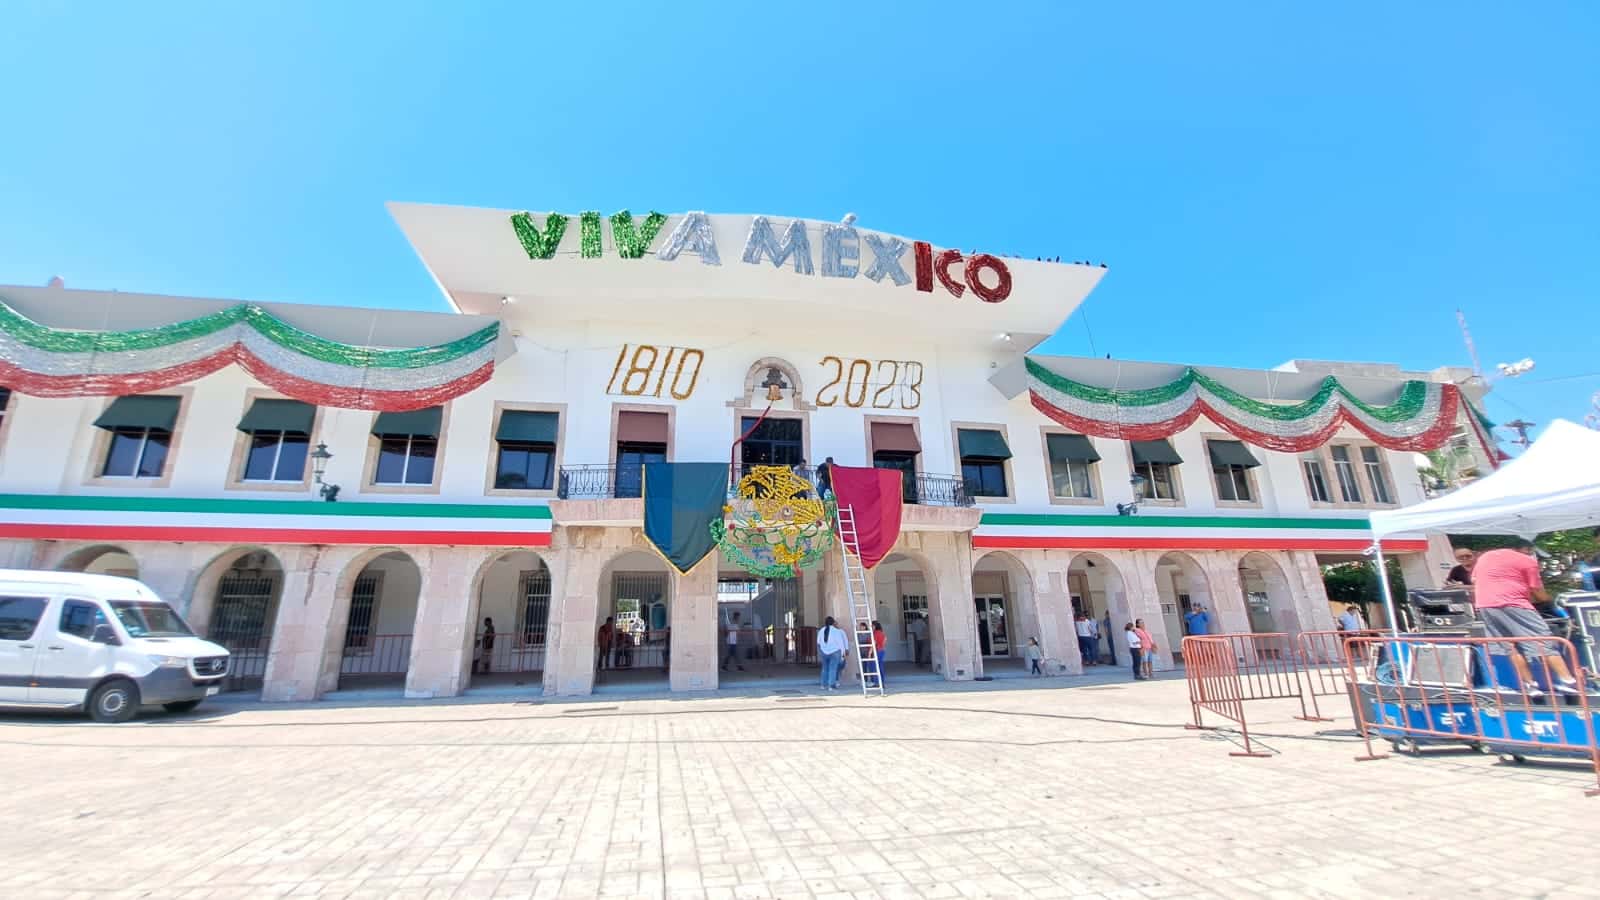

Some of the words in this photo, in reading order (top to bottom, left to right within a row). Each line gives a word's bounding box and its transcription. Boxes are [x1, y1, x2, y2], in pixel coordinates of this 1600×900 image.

[511, 211, 722, 265] VIVA
[742, 213, 1012, 303] MÉXICO
[606, 344, 704, 400] 1810
[816, 356, 923, 409] 2023
